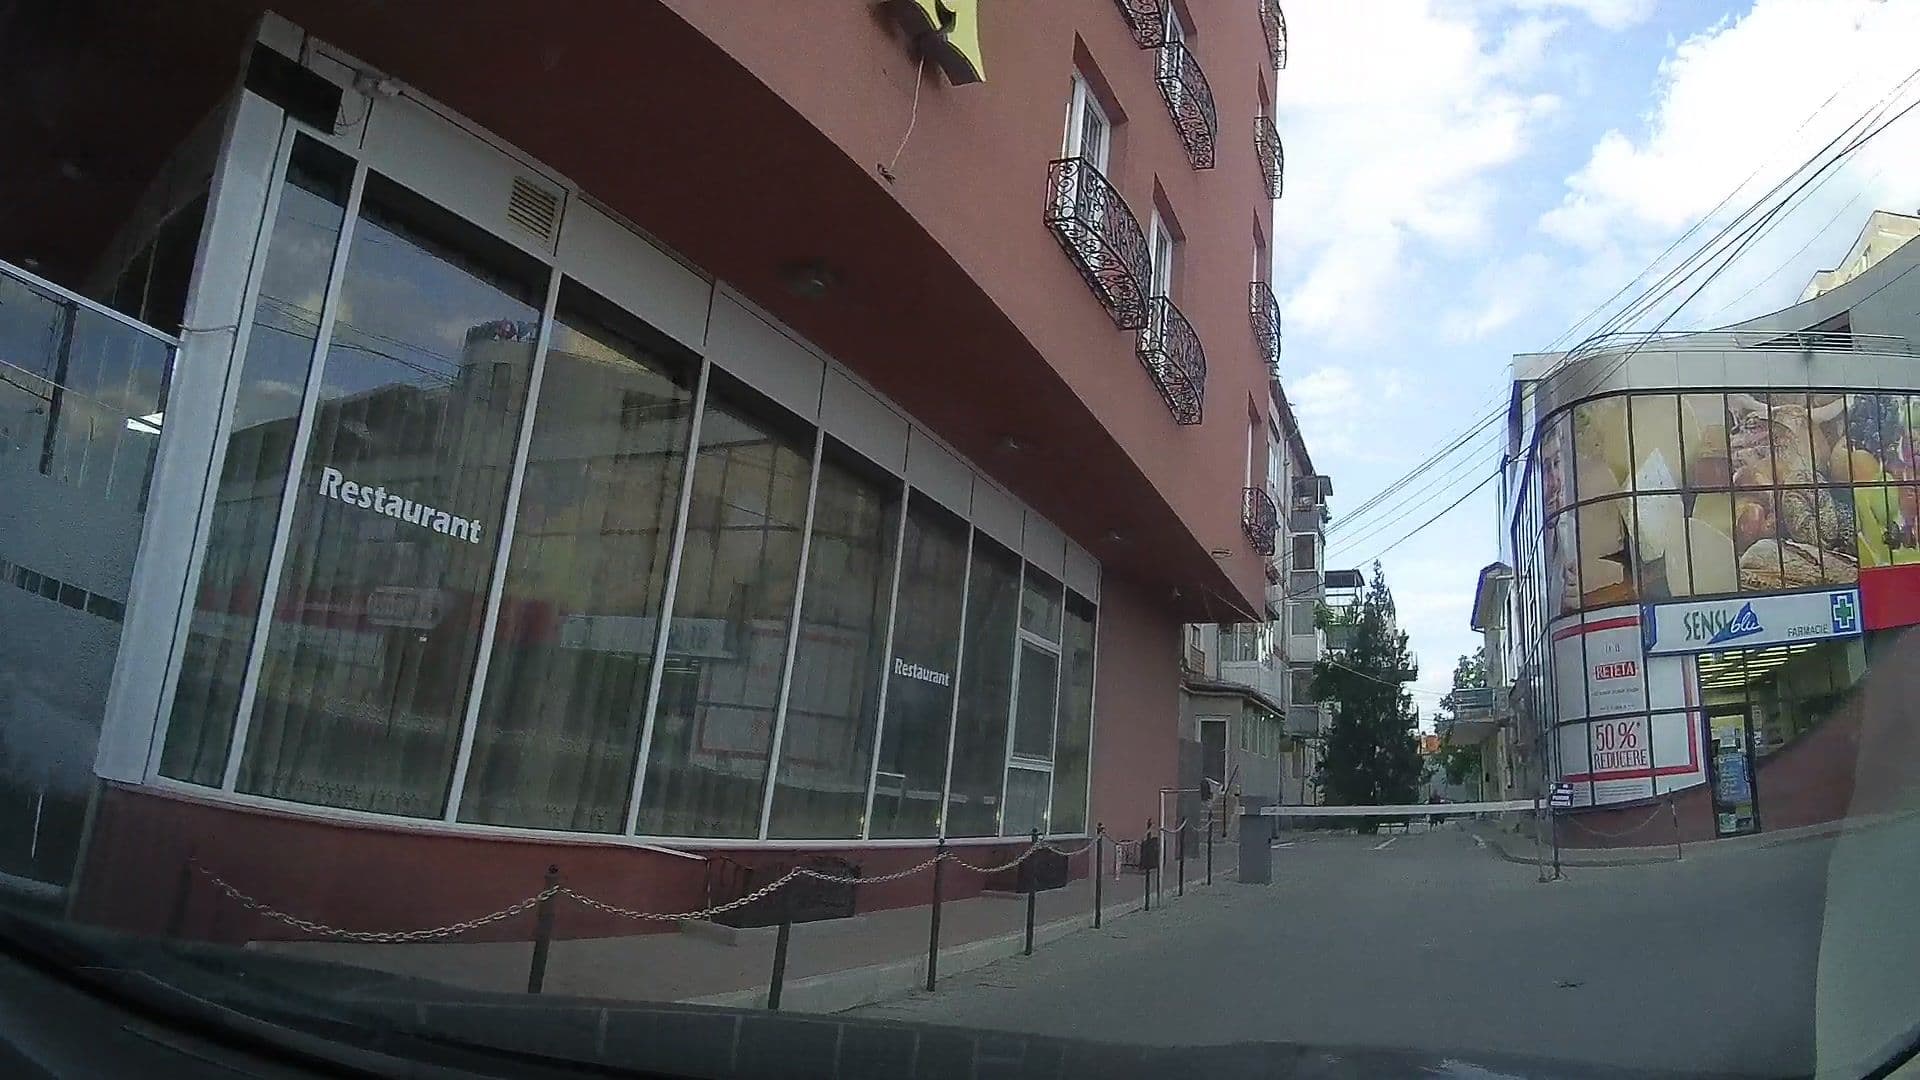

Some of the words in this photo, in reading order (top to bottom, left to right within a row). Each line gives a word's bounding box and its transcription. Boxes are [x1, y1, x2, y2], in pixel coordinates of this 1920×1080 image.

[319, 467, 482, 544] Restaurant
[1787, 623, 1829, 638] FARMACIE
[894, 657, 950, 687] Restaurant
[1594, 749, 1648, 770] REDUCERE
